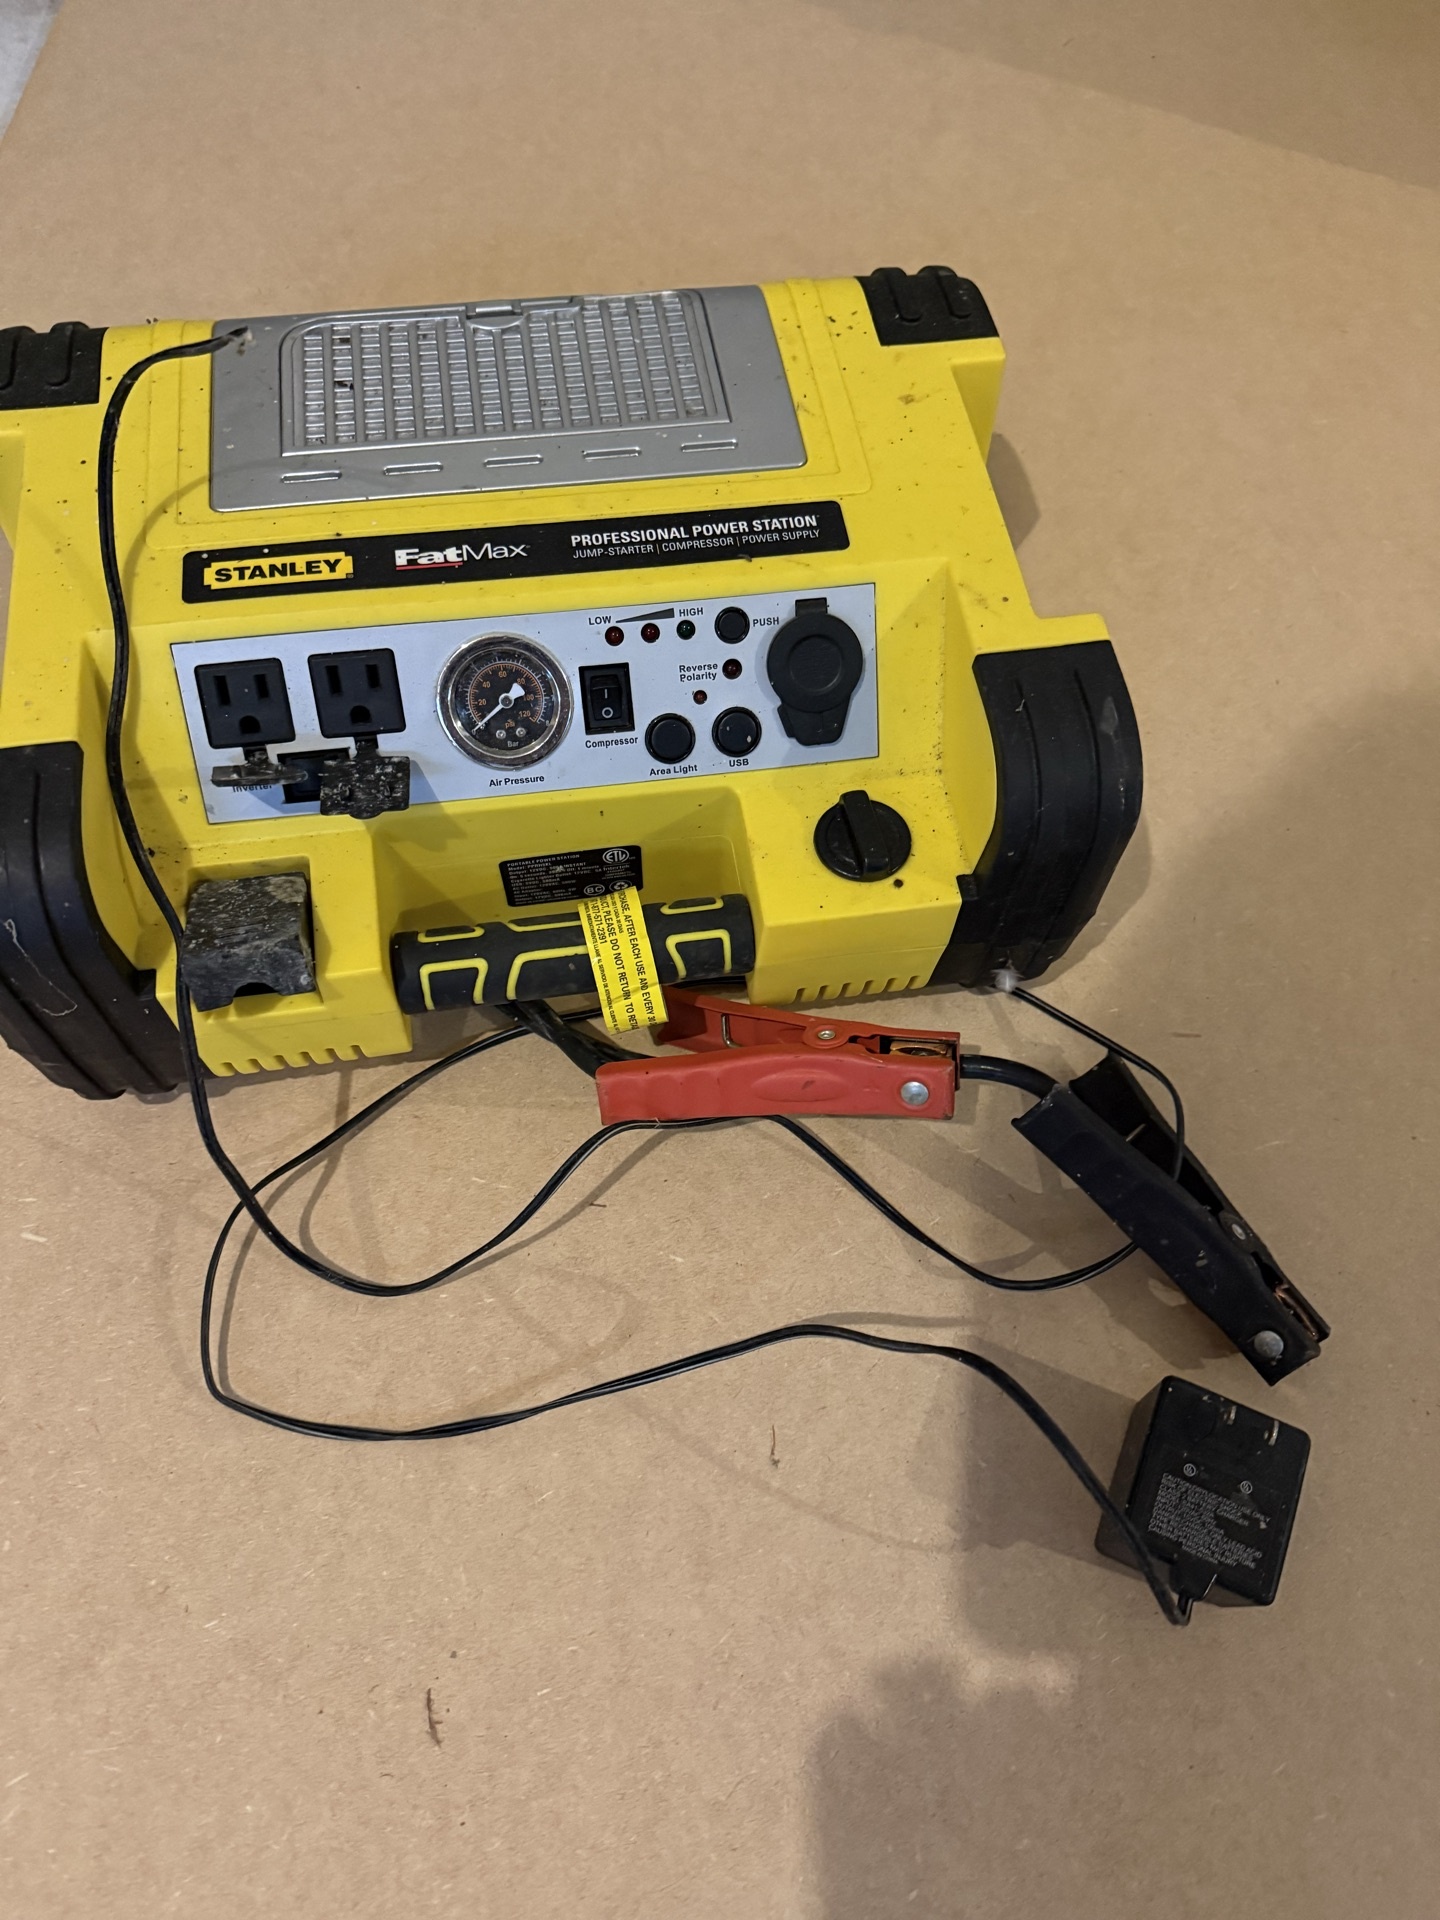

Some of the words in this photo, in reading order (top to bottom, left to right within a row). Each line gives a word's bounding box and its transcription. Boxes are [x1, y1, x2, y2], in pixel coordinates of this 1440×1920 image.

[571, 527, 690, 547] PROFESSIONAL
[692, 521, 749, 537] POWER
[752, 515, 818, 532] STATION
[573, 543, 654, 559] JUMP-STARTER
[662, 537, 734, 552] COMPRESSOR
[742, 533, 780, 544] POWER
[782, 529, 820, 542] SUPPLY
[394, 543, 526, 567] FatMax
[214, 558, 342, 582] STANLEY
[679, 607, 704, 617] HIGH
[588, 616, 612, 625] LOW
[753, 617, 779, 627] PUSH
[679, 663, 718, 673] Reverse
[680, 672, 717, 682] Polarity
[585, 736, 638, 749] Compressor
[649, 766, 671, 776] Area
[674, 764, 698, 775] Light
[729, 758, 749, 767] USB
[489, 778, 503, 787] Air
[504, 774, 545, 786] Pressure
[603, 910, 616, 937] PLEASE
[623, 913, 636, 937] AFTER
[609, 938, 620, 951] DO
[629, 937, 641, 959] EACH
[613, 952, 624, 970] NOT
[635, 960, 645, 975] USE
[617, 971, 631, 1000] RETURN
[638, 976, 648, 991] AND
[624, 1003, 634, 1013] TO
[641, 991, 654, 1015] EVERY
